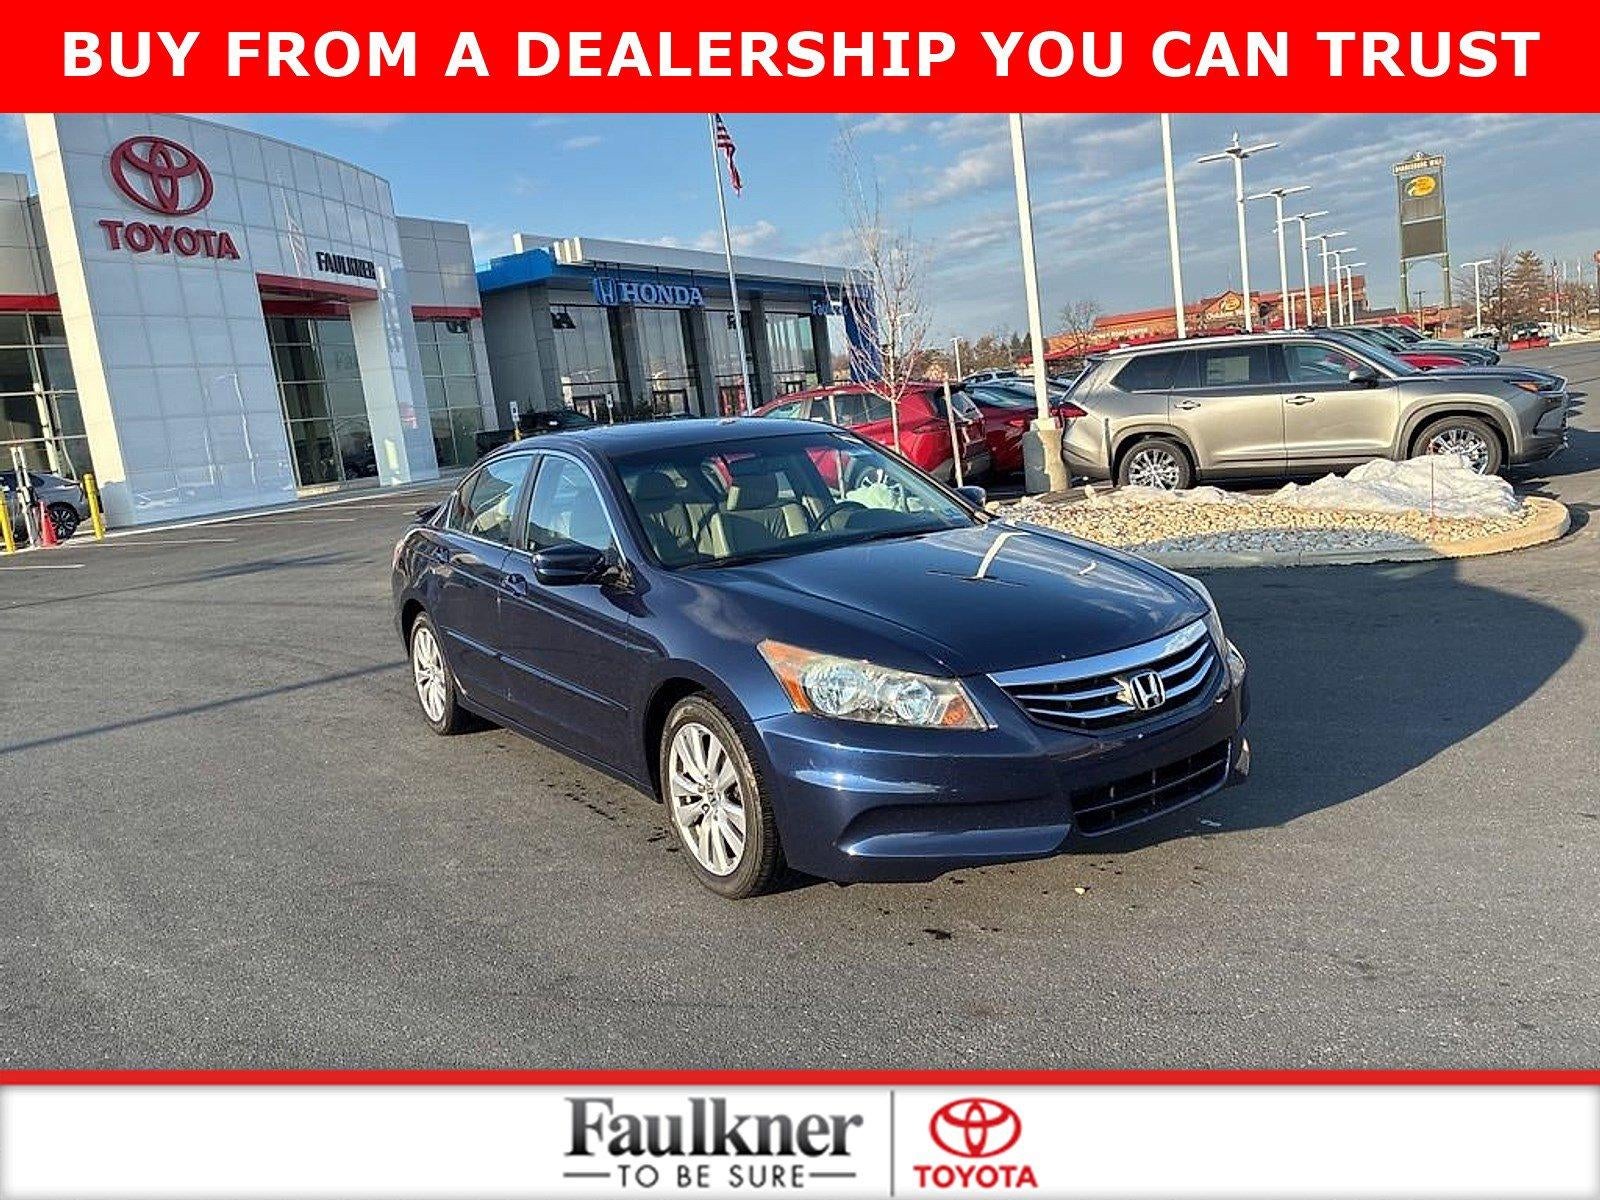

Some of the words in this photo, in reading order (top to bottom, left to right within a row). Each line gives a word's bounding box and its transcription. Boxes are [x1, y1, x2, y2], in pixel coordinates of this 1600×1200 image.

[98, 219, 241, 260] TOYOTA
[315, 251, 377, 280] FAULKNER
[618, 282, 705, 306] HONDA
